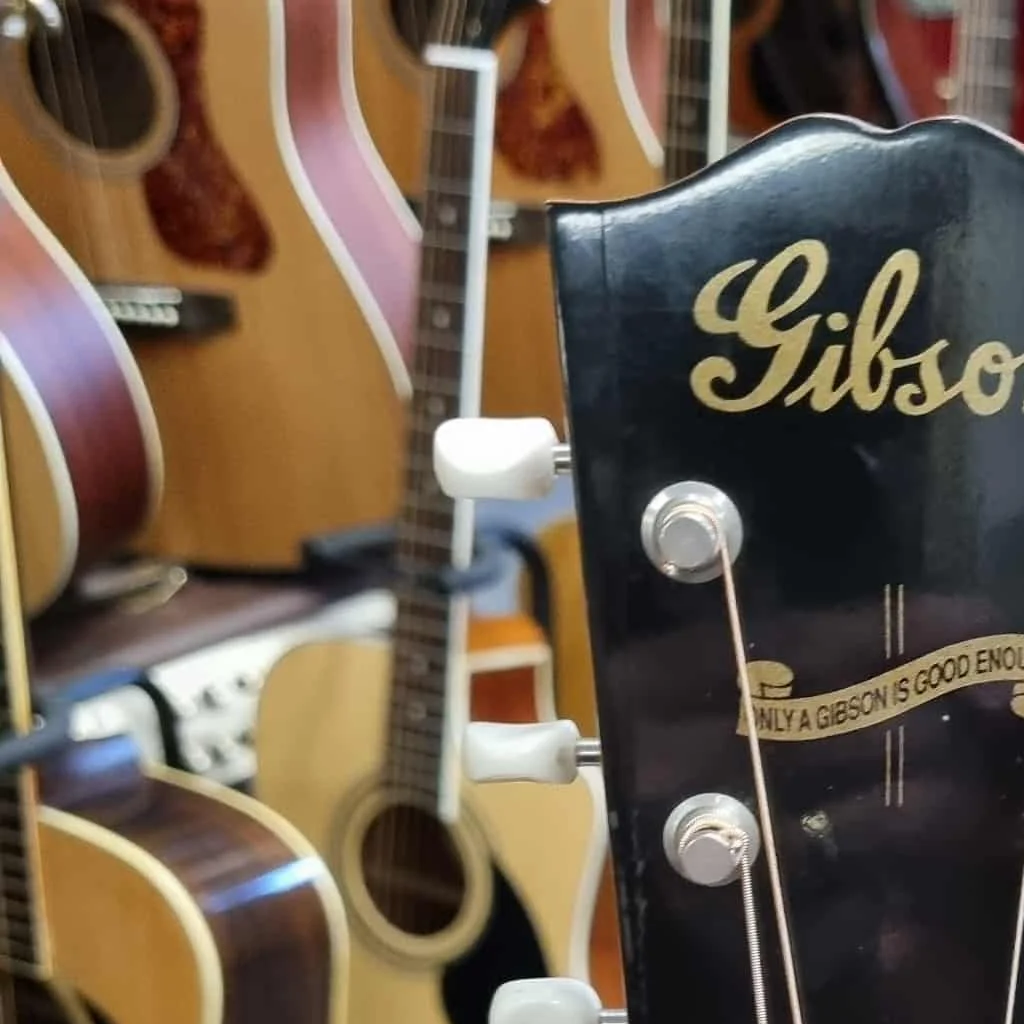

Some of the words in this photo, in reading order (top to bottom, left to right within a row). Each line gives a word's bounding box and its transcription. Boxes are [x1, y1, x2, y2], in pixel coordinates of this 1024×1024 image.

[799, 708, 812, 731] A
[817, 686, 887, 729] GIBSON
[891, 682, 909, 704] IS
[914, 654, 970, 696] GOOD
